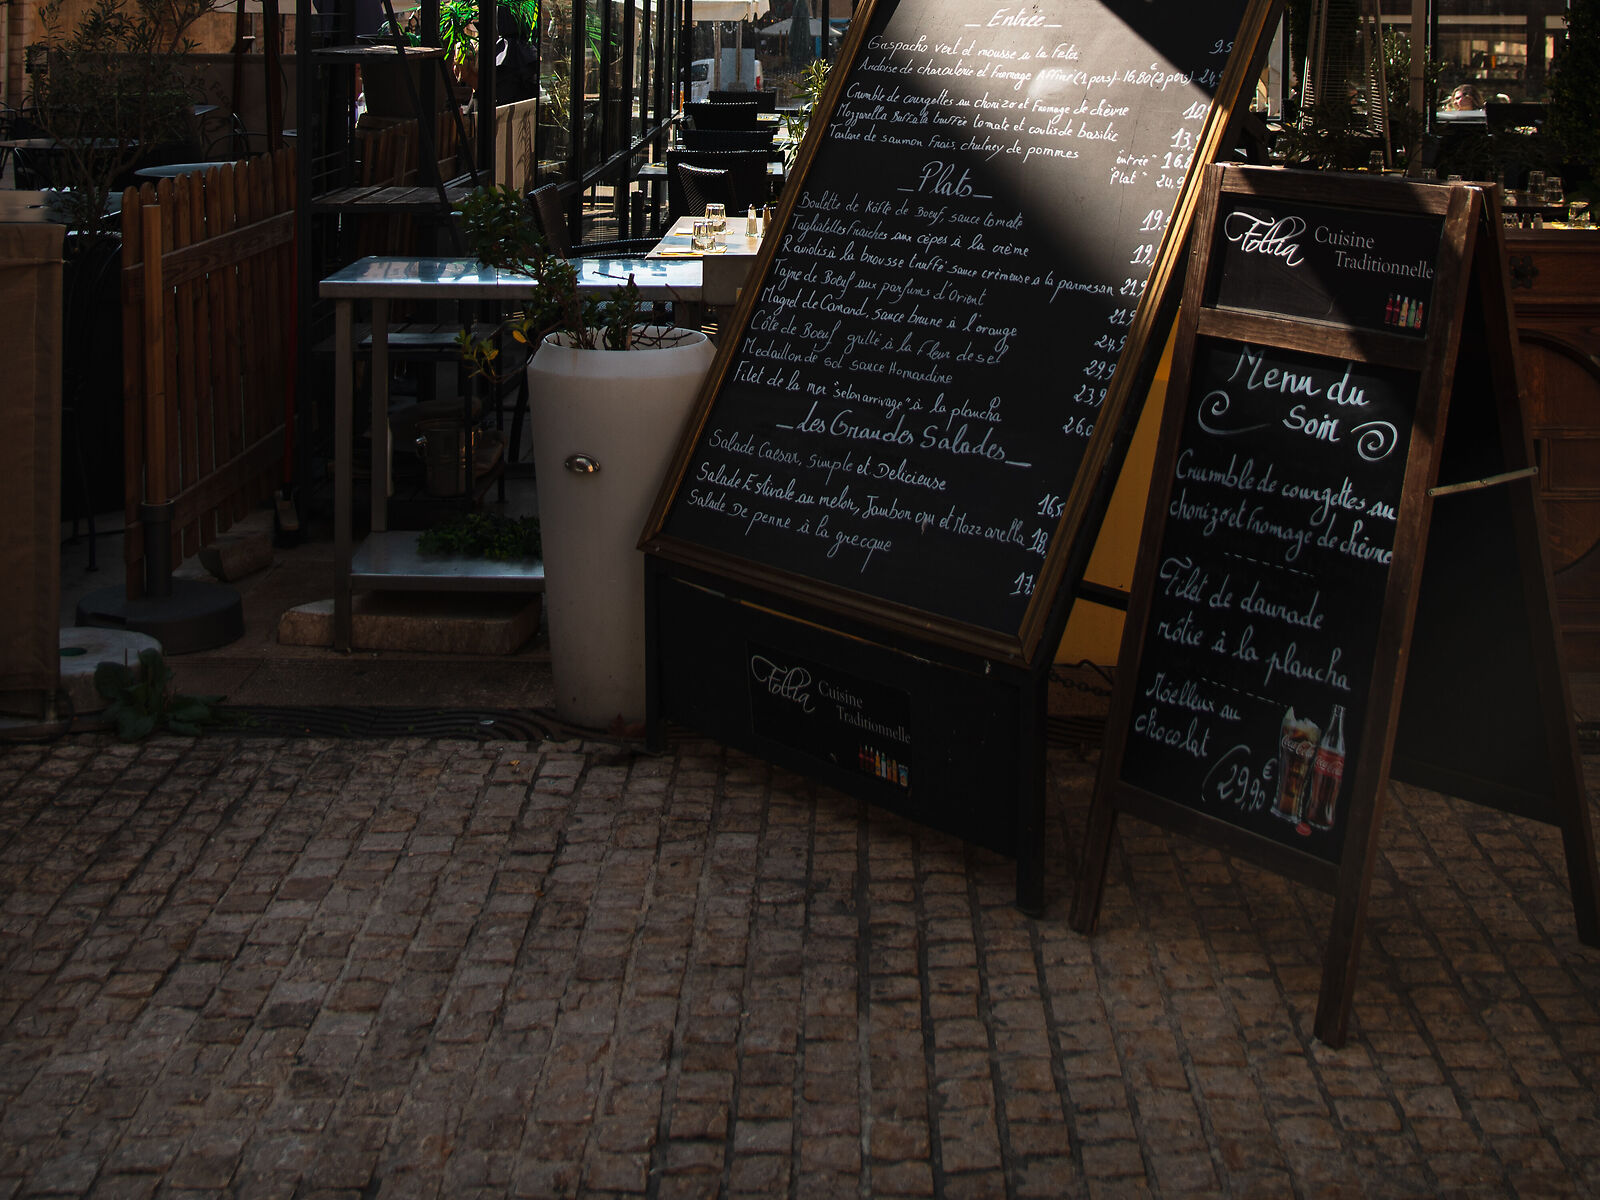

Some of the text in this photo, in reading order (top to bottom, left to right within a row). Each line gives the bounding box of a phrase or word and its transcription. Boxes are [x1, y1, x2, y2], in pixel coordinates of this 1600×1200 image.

[987, 8, 1047, 27] Entrée
[868, 34, 927, 59] Gaspacho
[934, 37, 962, 55] vert
[962, 39, 976, 55] et
[978, 47, 1016, 59] mousse
[1035, 46, 1048, 58] la
[900, 59, 913, 74] de
[977, 62, 991, 77] et
[846, 82, 884, 102] Crumble
[887, 86, 899, 102] de
[903, 89, 953, 117] courgettes
[974, 91, 1016, 110] chorizo
[1018, 98, 1029, 109] et
[1073, 99, 1088, 114] de
[1090, 98, 1130, 116] chèvre
[830, 123, 1079, 163] Tartare de saumon chutney de pommes
[836, 103, 888, 126] Mozzarella
[973, 113, 1009, 131] tomate
[1014, 117, 1025, 131] et
[1057, 119, 1073, 136] de
[1078, 122, 1118, 142] basilic
[918, 160, 973, 197] Plats
[798, 191, 840, 210] Boulette
[846, 193, 859, 211] de
[895, 199, 908, 215] de
[948, 211, 980, 225] sauce
[983, 211, 1024, 230] tomate
[793, 213, 847, 242] Tagliatelles
[892, 232, 911, 242] aux
[950, 236, 961, 248] à
[968, 234, 985, 251] la
[993, 244, 1030, 257] crème
[1224, 212, 1375, 267] Follia Cuisine
[782, 234, 826, 255] Raviolis
[840, 241, 854, 261] la
[861, 245, 904, 268] brousse
[947, 264, 978, 278] sauce
[1045, 271, 1053, 286] la
[1050, 279, 1113, 304] parmesan
[804, 262, 817, 283] de
[855, 278, 876, 289] aux
[876, 278, 931, 304] parfums
[1335, 251, 1434, 279] Traditionnelle
[761, 285, 802, 316] Magret
[802, 290, 818, 310] de
[872, 308, 904, 323] sauce
[908, 304, 942, 328] brune
[750, 310, 779, 331] Côte
[781, 315, 796, 335] de
[881, 338, 894, 350] à
[898, 332, 912, 352] la
[957, 342, 976, 362] de
[978, 344, 1009, 364] sel
[804, 351, 818, 363] de
[849, 360, 884, 372] sauce
[888, 361, 953, 384] Homardine
[1227, 345, 1371, 406] Menu du
[734, 360, 763, 383] Filet
[767, 368, 784, 387] de
[786, 370, 800, 391] la
[807, 381, 827, 394] mer
[910, 399, 924, 410] à
[930, 392, 946, 413] la
[946, 396, 1002, 432] plancha
[709, 429, 755, 455] Salade
[857, 456, 872, 475] et
[797, 401, 1006, 460] Les Grandes Salades
[697, 462, 742, 489] Salade
[742, 474, 795, 501] Estivale
[795, 492, 814, 504] au
[862, 495, 911, 520] Jambon
[939, 505, 954, 529] et
[1176, 448, 1397, 526] Crumble de courgettes au
[688, 489, 726, 512] Salade
[745, 512, 790, 536] penne
[797, 519, 810, 534] à
[816, 515, 829, 538] la
[827, 530, 891, 573] grecque
[1170, 488, 1231, 537] chorizo
[1229, 499, 1245, 528] et
[1318, 512, 1336, 548] de
[1160, 556, 1324, 629] Filet de daurade
[1158, 610, 1351, 690] rôtie à la plancha
[752, 655, 864, 714] Follia Cuisine
[836, 706, 911, 744] Traditionnelle
[1219, 705, 1242, 720] au
